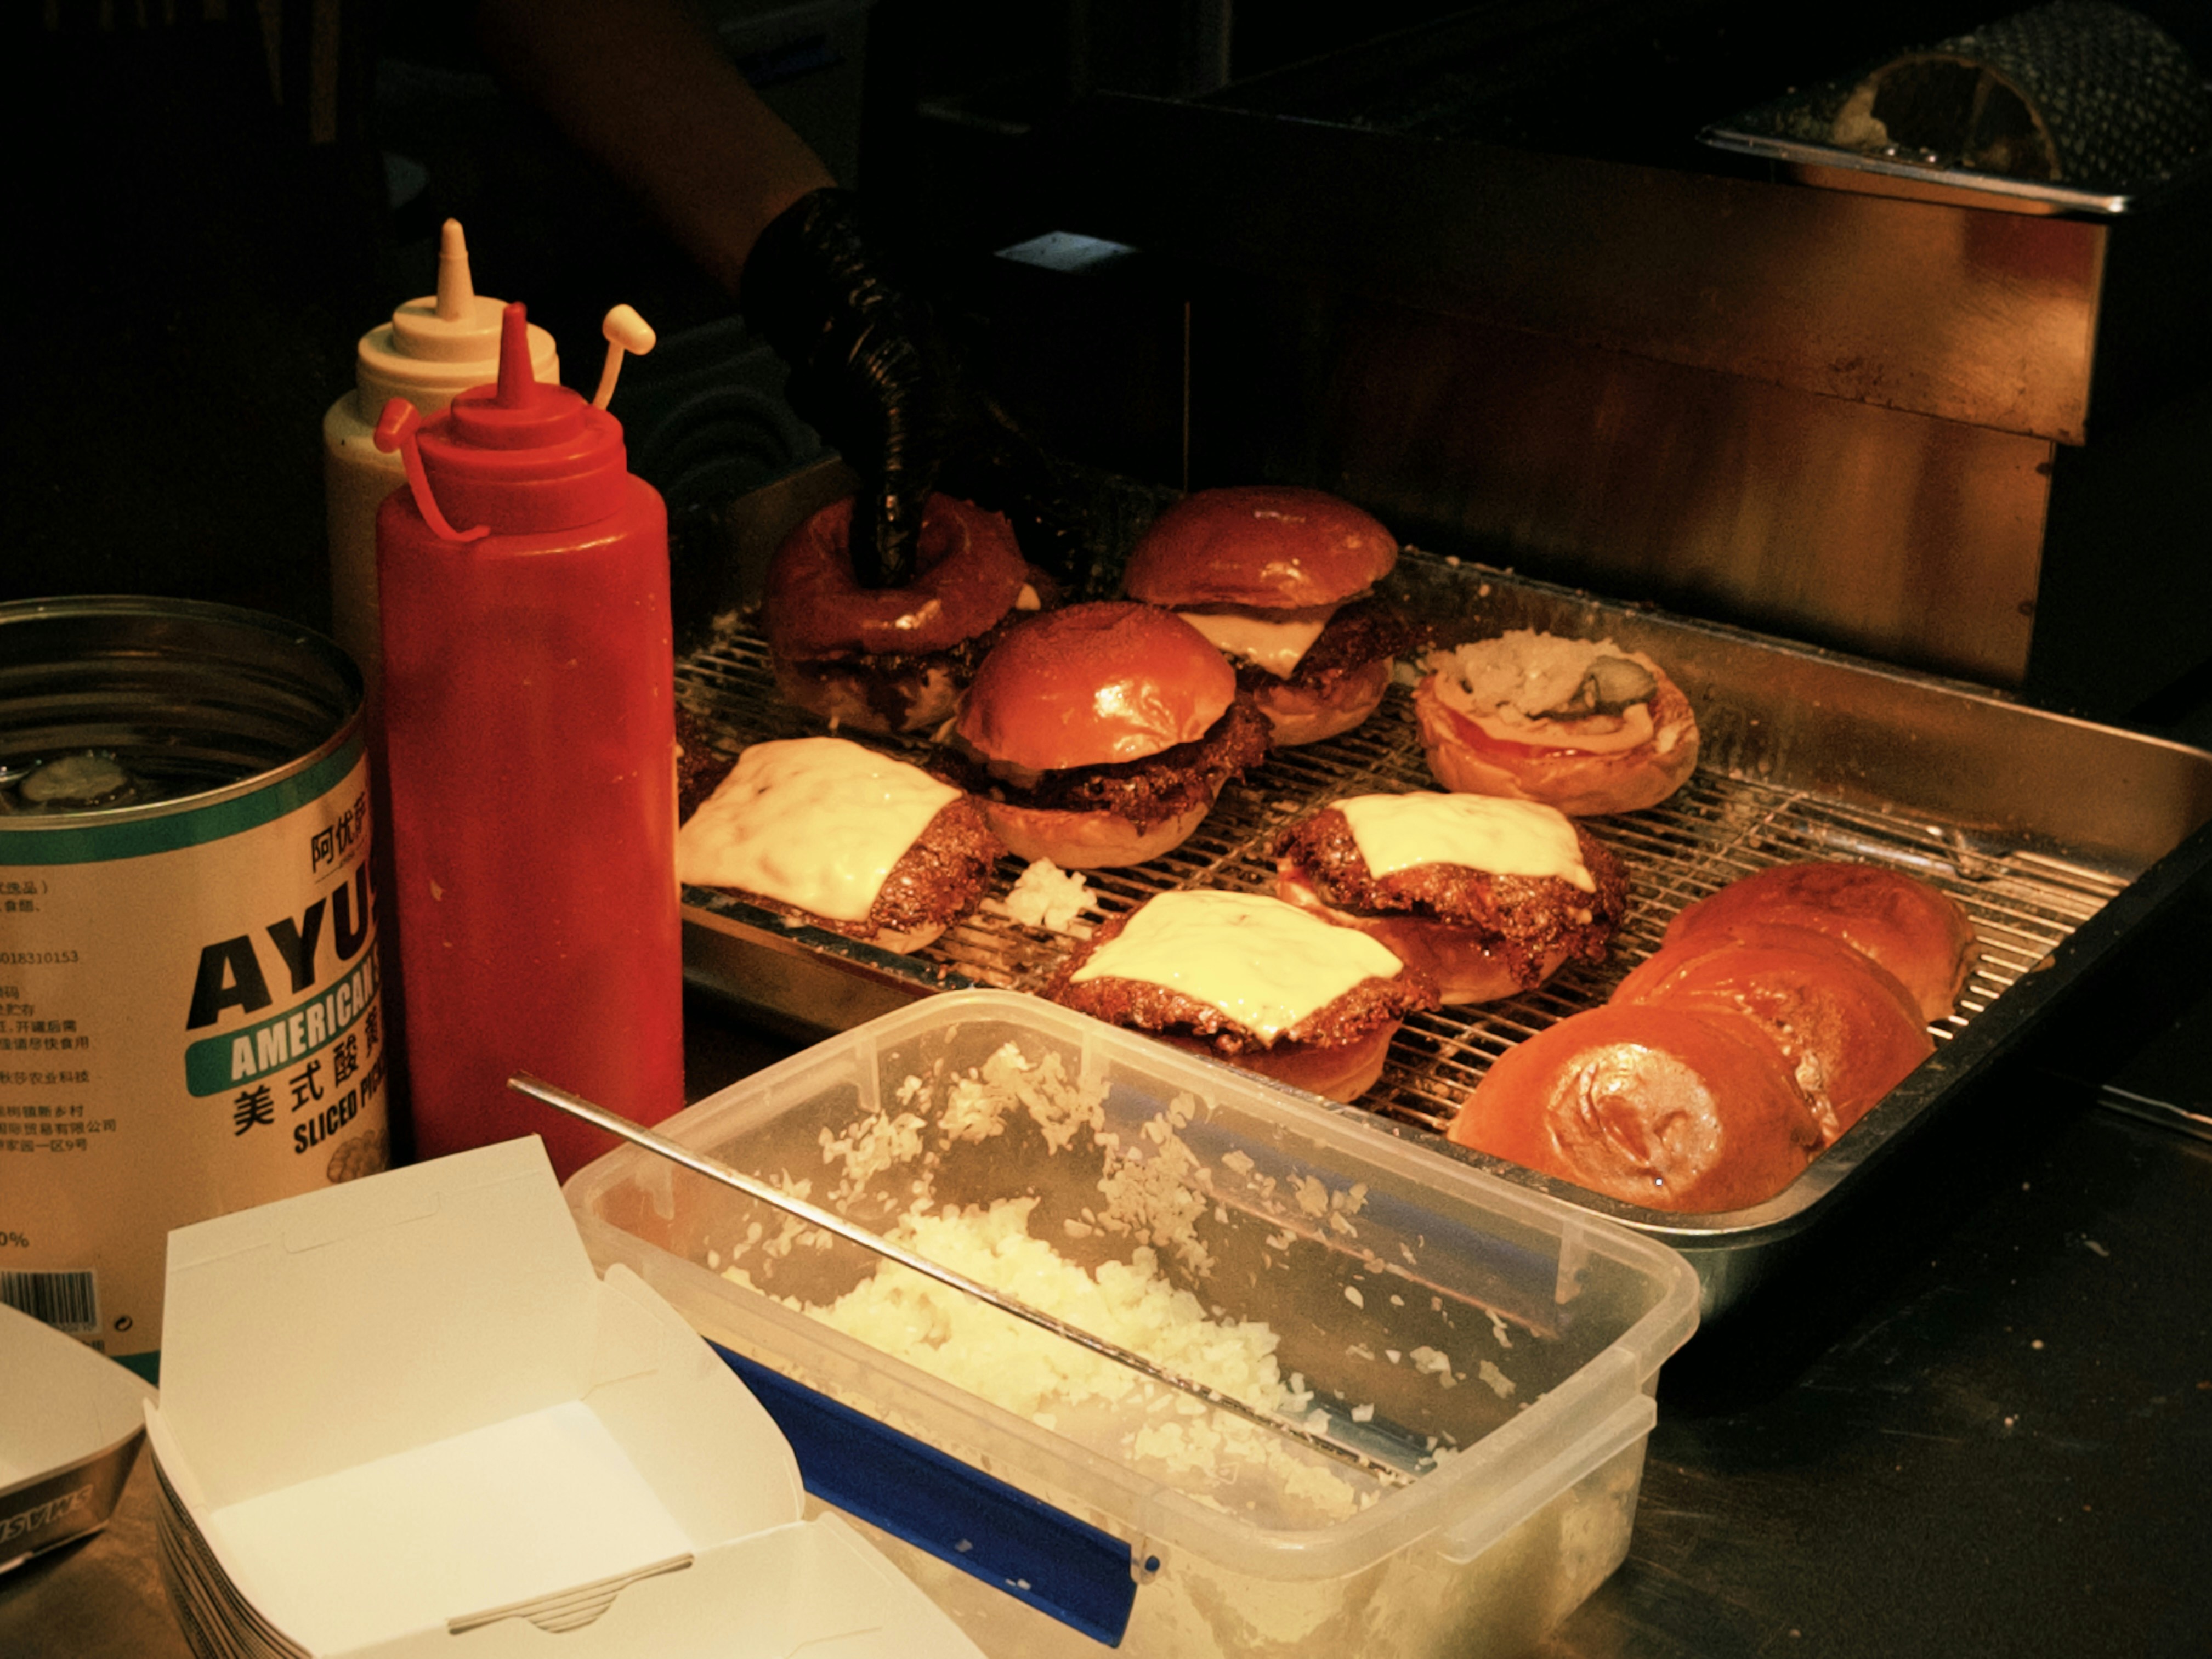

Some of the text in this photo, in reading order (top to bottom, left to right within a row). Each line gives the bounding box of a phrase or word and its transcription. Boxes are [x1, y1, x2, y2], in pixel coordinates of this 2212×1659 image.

[0, 950, 78, 965] 018310153
[231, 955, 373, 1081] AMERICAN
[293, 1088, 358, 1154] SLICED
